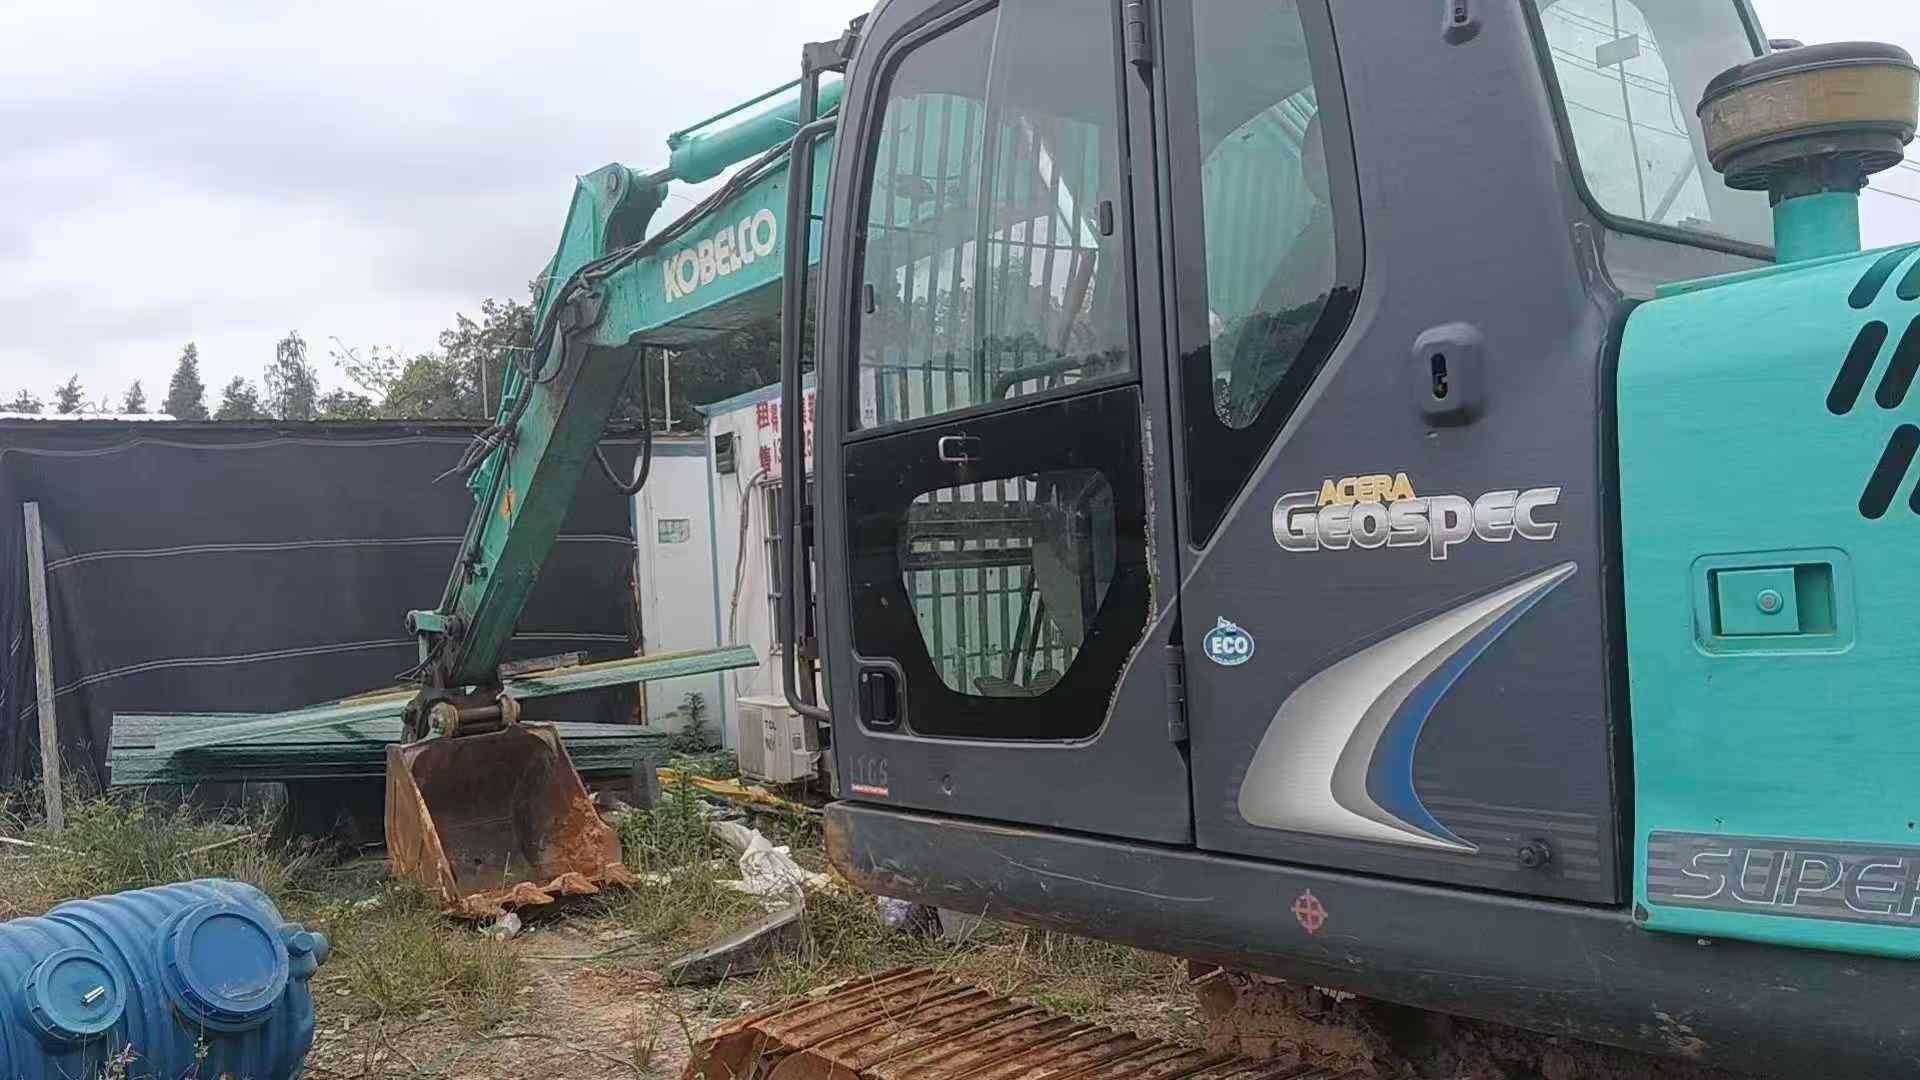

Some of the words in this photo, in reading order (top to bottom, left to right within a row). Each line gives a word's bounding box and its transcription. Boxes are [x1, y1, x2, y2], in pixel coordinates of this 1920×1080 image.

[663, 208, 777, 303] KOBELCO
[1318, 472, 1416, 506] ACERA
[1212, 636, 1248, 654] ECO
